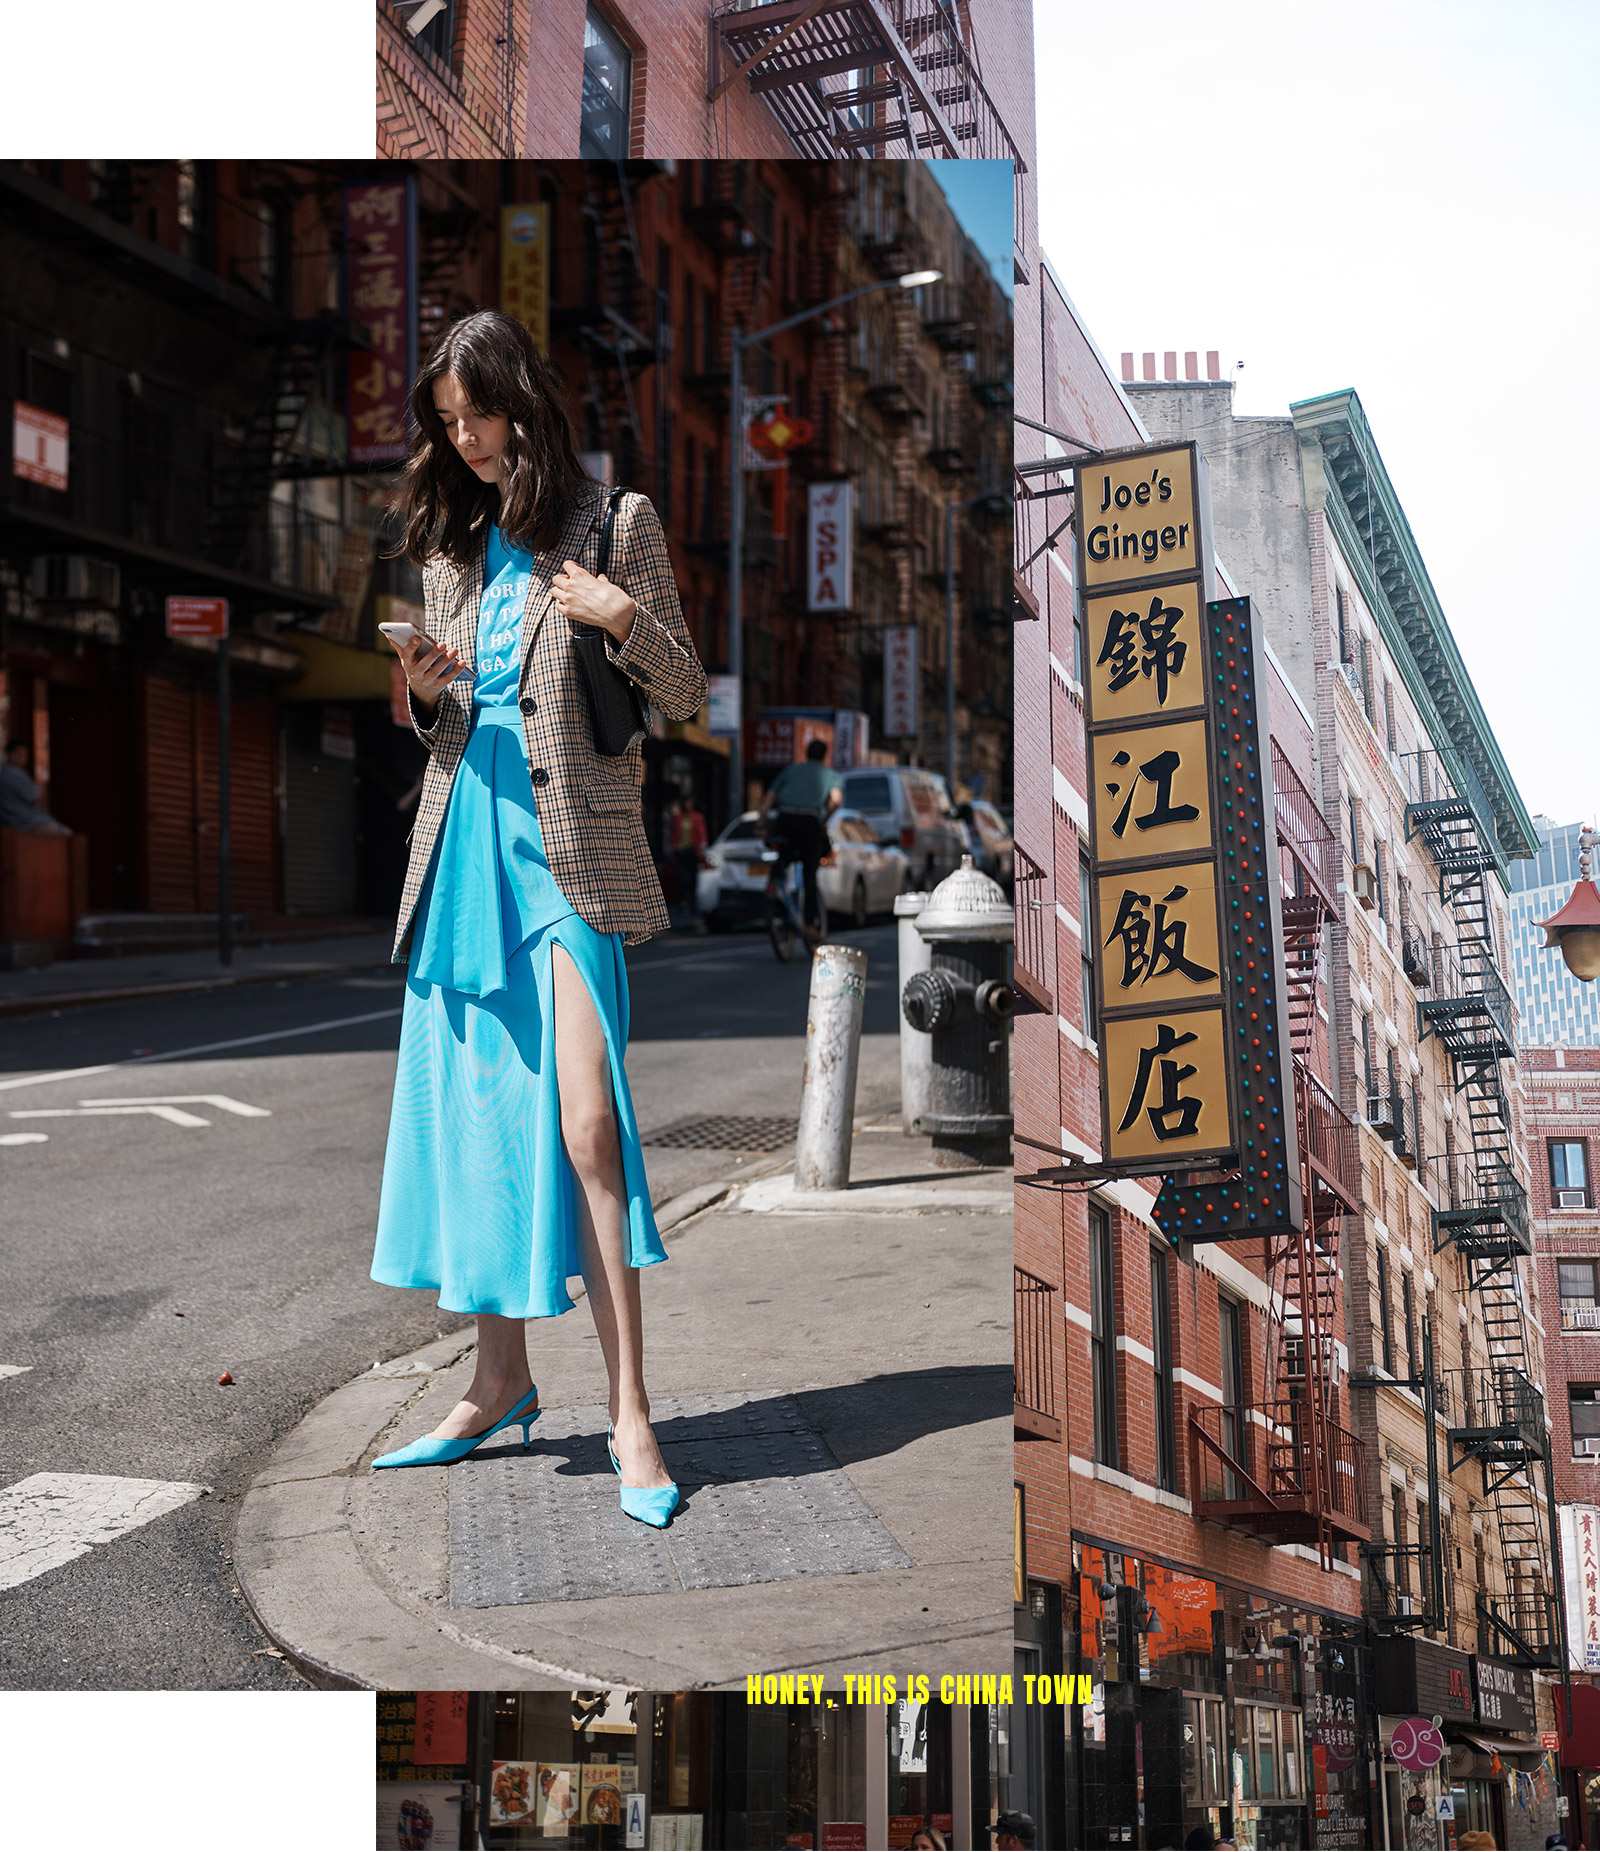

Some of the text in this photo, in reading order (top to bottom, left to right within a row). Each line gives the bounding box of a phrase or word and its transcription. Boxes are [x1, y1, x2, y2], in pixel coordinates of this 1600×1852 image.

[1100, 469, 1173, 513] Joe's
[816, 523, 837, 601] SPA
[1087, 522, 1190, 563] Ginger
[1096, 596, 1220, 1142] 錦江飯店
[629, 1800, 642, 1833] A
[1439, 1799, 1451, 1813] A
